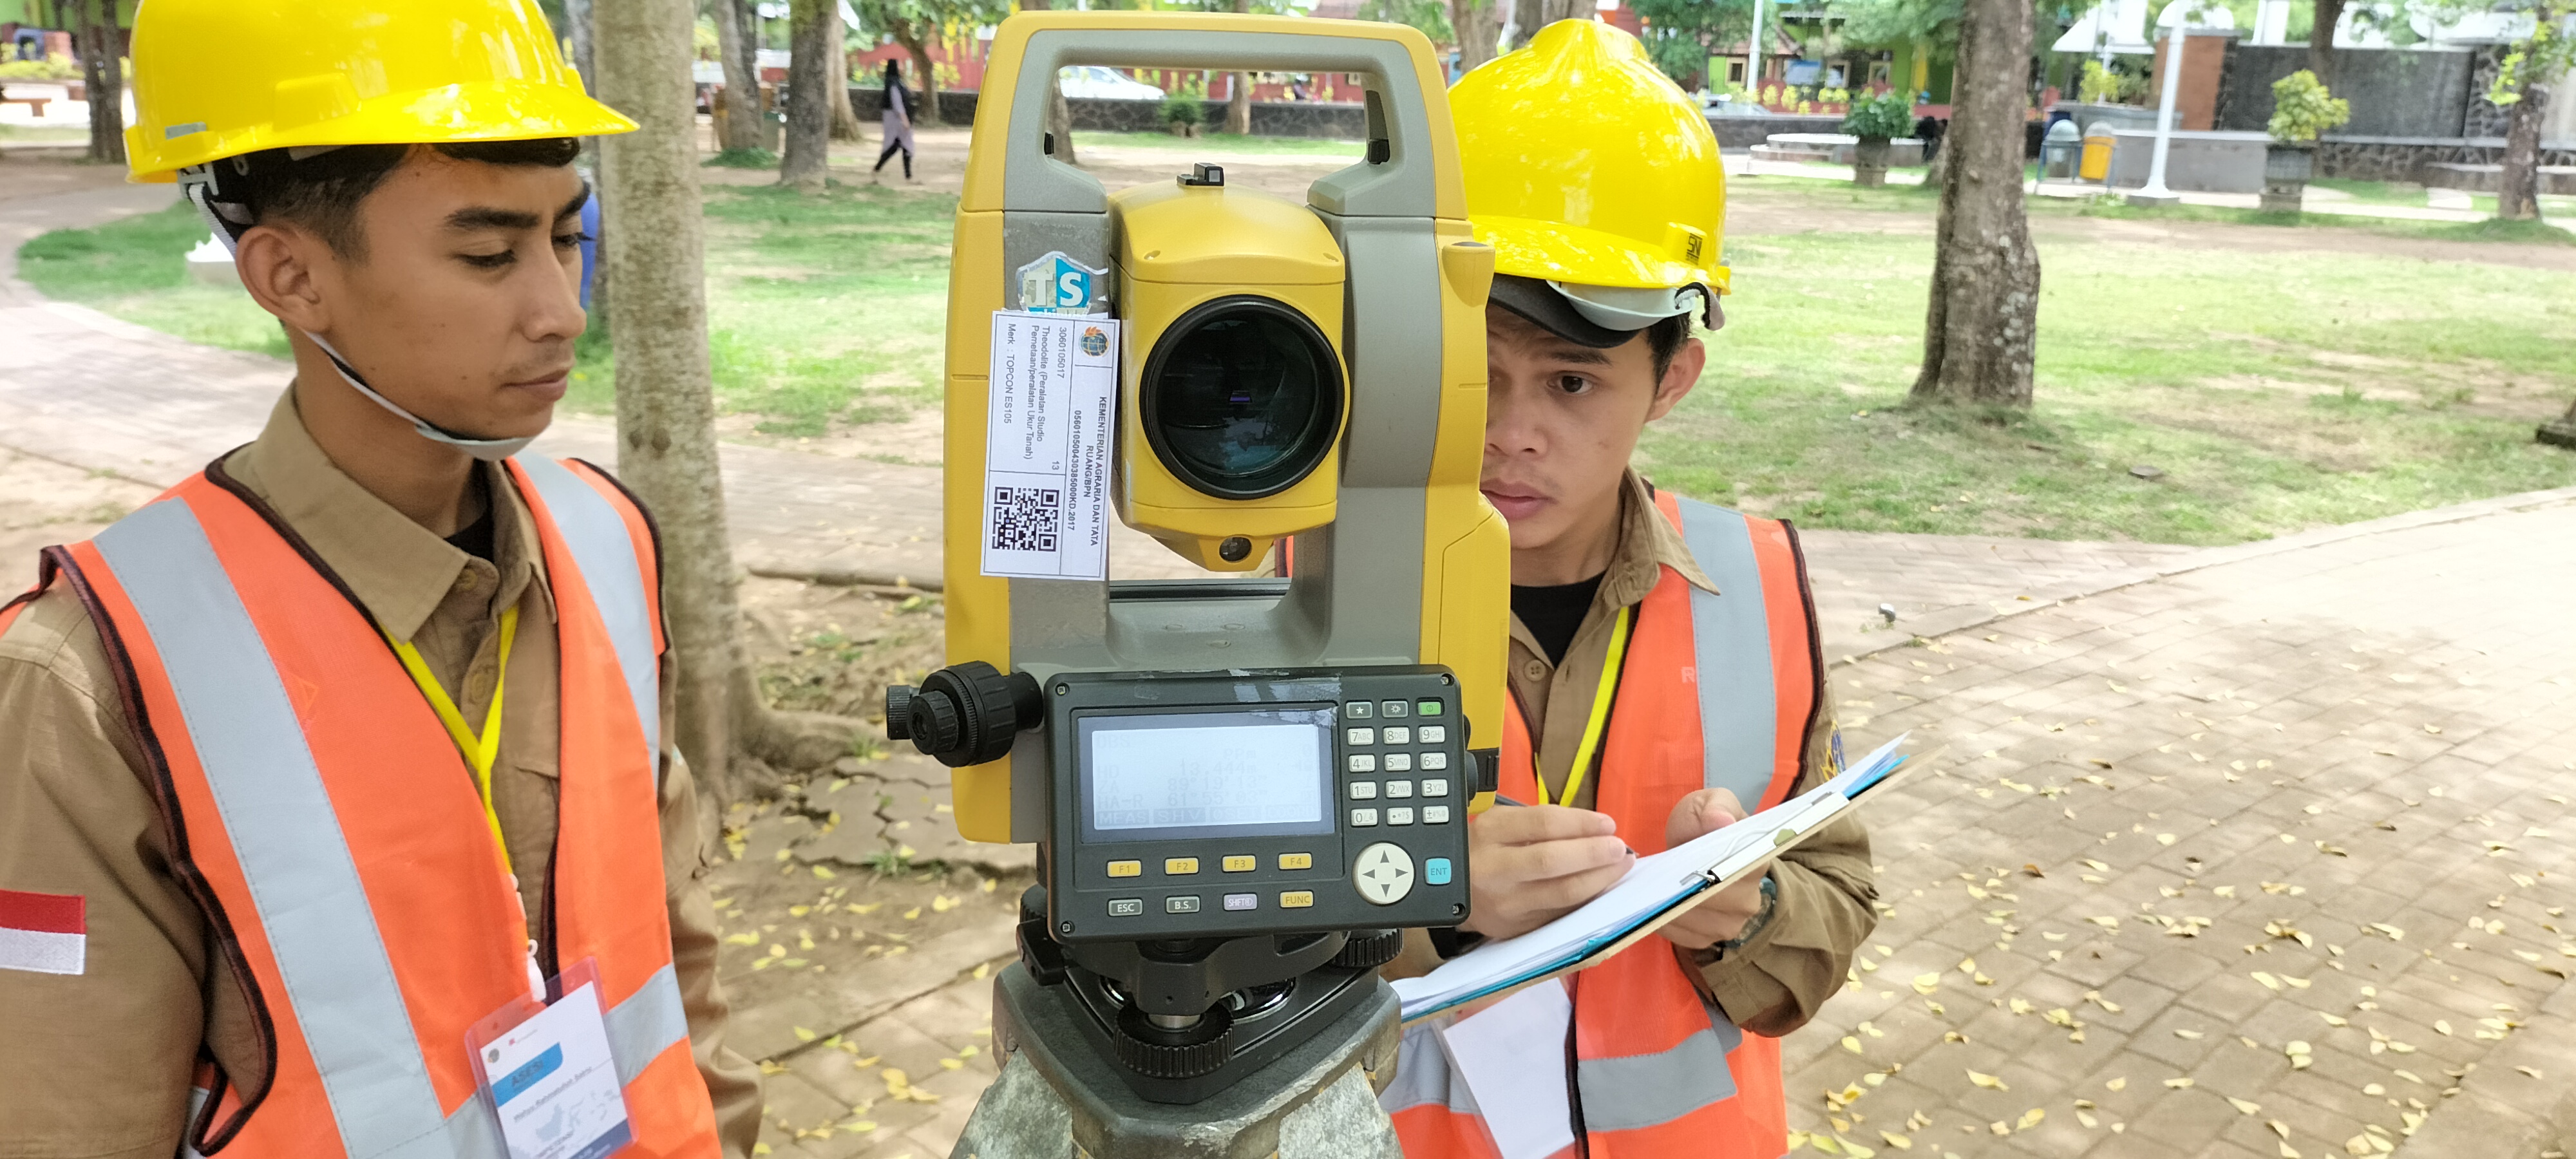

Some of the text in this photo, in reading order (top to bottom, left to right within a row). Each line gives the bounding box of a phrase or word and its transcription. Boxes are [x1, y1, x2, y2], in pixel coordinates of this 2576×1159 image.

[1007, 323, 1016, 344] Merk
[1057, 327, 1067, 379] 3060105017
[1005, 354, 1015, 394] TOPCON
[1036, 326, 1050, 442] Theodolite (Peralatan Studio
[1023, 325, 1039, 460] Pemetaan/peralatan Ukur Tanah)
[1003, 396, 1013, 424] ES105
[1096, 397, 1107, 460] KEMENTERIAN
[1052, 460, 1059, 471] 13
[1083, 445, 1094, 498] RUANG/BPN
[1093, 462, 1103, 502] AGRARIA
[1092, 505, 1101, 523] DAN
[1099, 811, 1148, 824] MEAS
[1177, 862, 1188, 871] F2
[1234, 860, 1245, 868] F3
[1291, 857, 1302, 865] F4
[1119, 865, 1130, 873] F1
[1430, 867, 1448, 876] ENT
[1117, 903, 1134, 912] ESC
[1175, 901, 1191, 909] B.S.
[1285, 895, 1310, 905] FUNC
